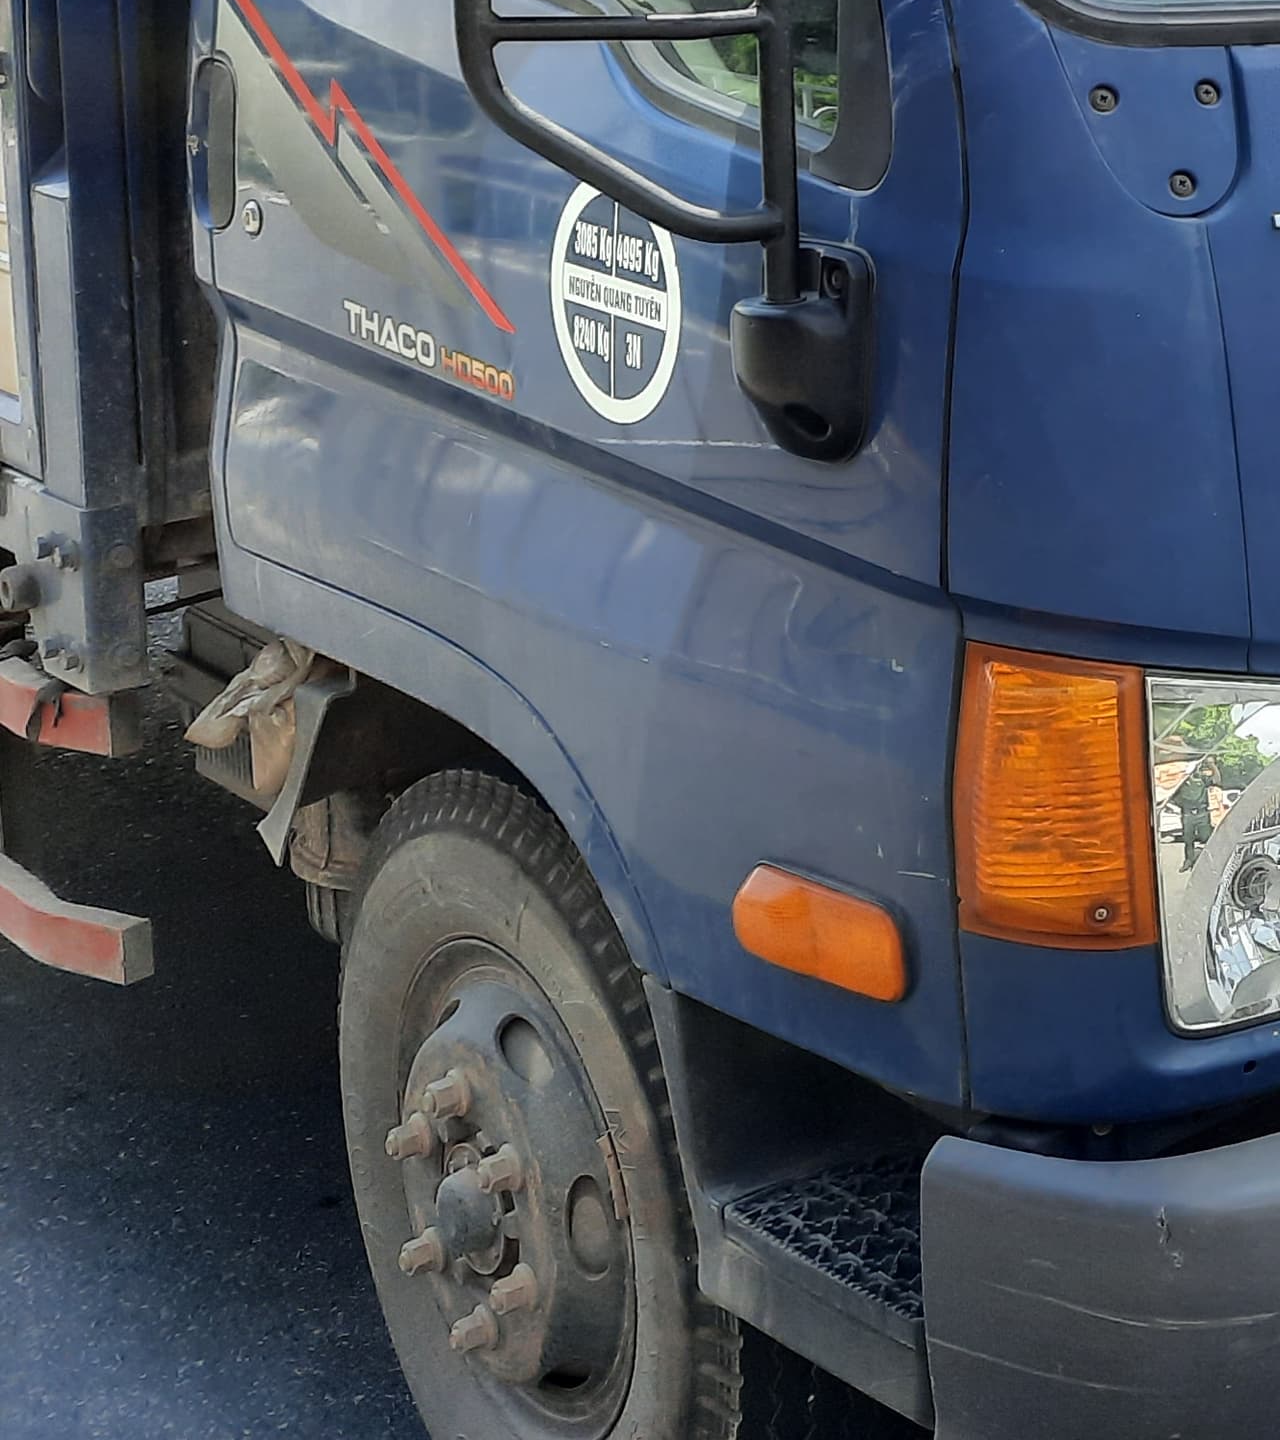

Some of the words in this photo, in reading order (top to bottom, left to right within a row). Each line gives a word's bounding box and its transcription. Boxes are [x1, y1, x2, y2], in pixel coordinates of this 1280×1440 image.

[574, 221, 598, 259] 3085
[603, 284, 632, 313] QUANG
[343, 299, 436, 367] THACO
[440, 345, 514, 401] HD500
